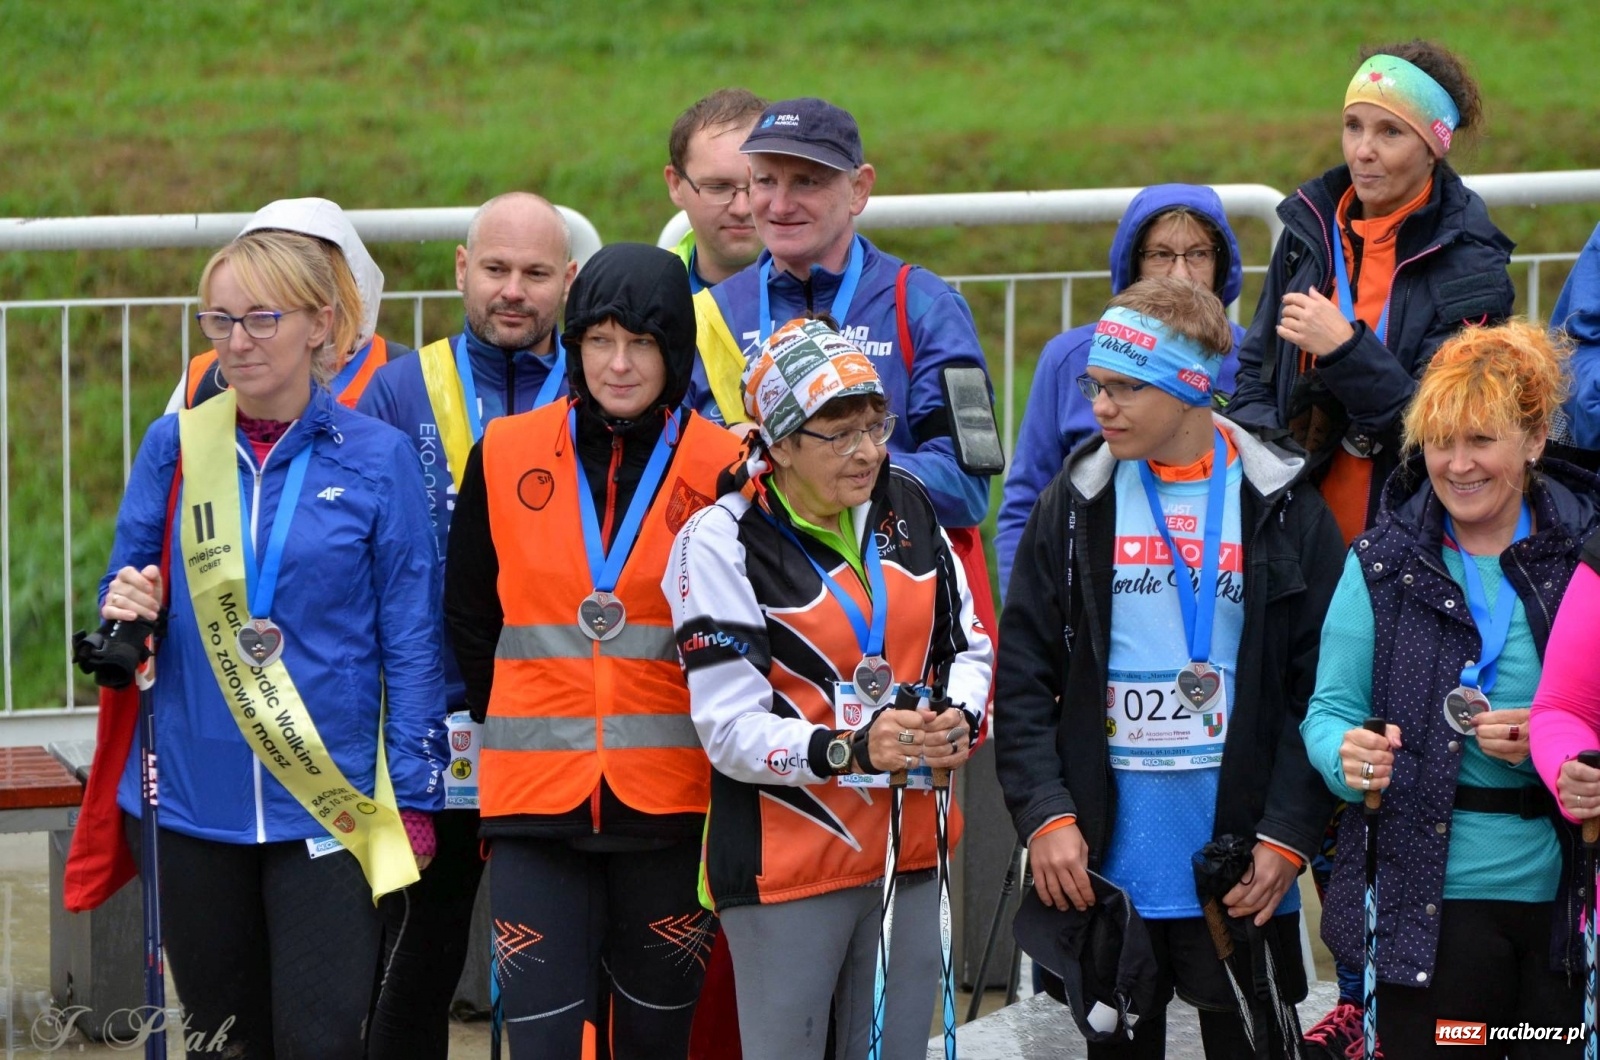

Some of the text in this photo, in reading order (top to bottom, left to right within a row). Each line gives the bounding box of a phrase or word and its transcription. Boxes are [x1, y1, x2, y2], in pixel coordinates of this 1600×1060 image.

[1097, 334, 1150, 367] Walking
[316, 486, 345, 501] 4F
[1163, 503, 1194, 516] JUST
[192, 501, 215, 544] II
[188, 544, 232, 567] miejsce
[199, 558, 222, 574] KOBIET
[207, 620, 292, 769] Po zdrowie marsz
[1123, 688, 1192, 721] 022
[250, 665, 280, 709] ordic
[275, 709, 322, 775] Walking
[941, 894, 950, 952] NEATNESS
